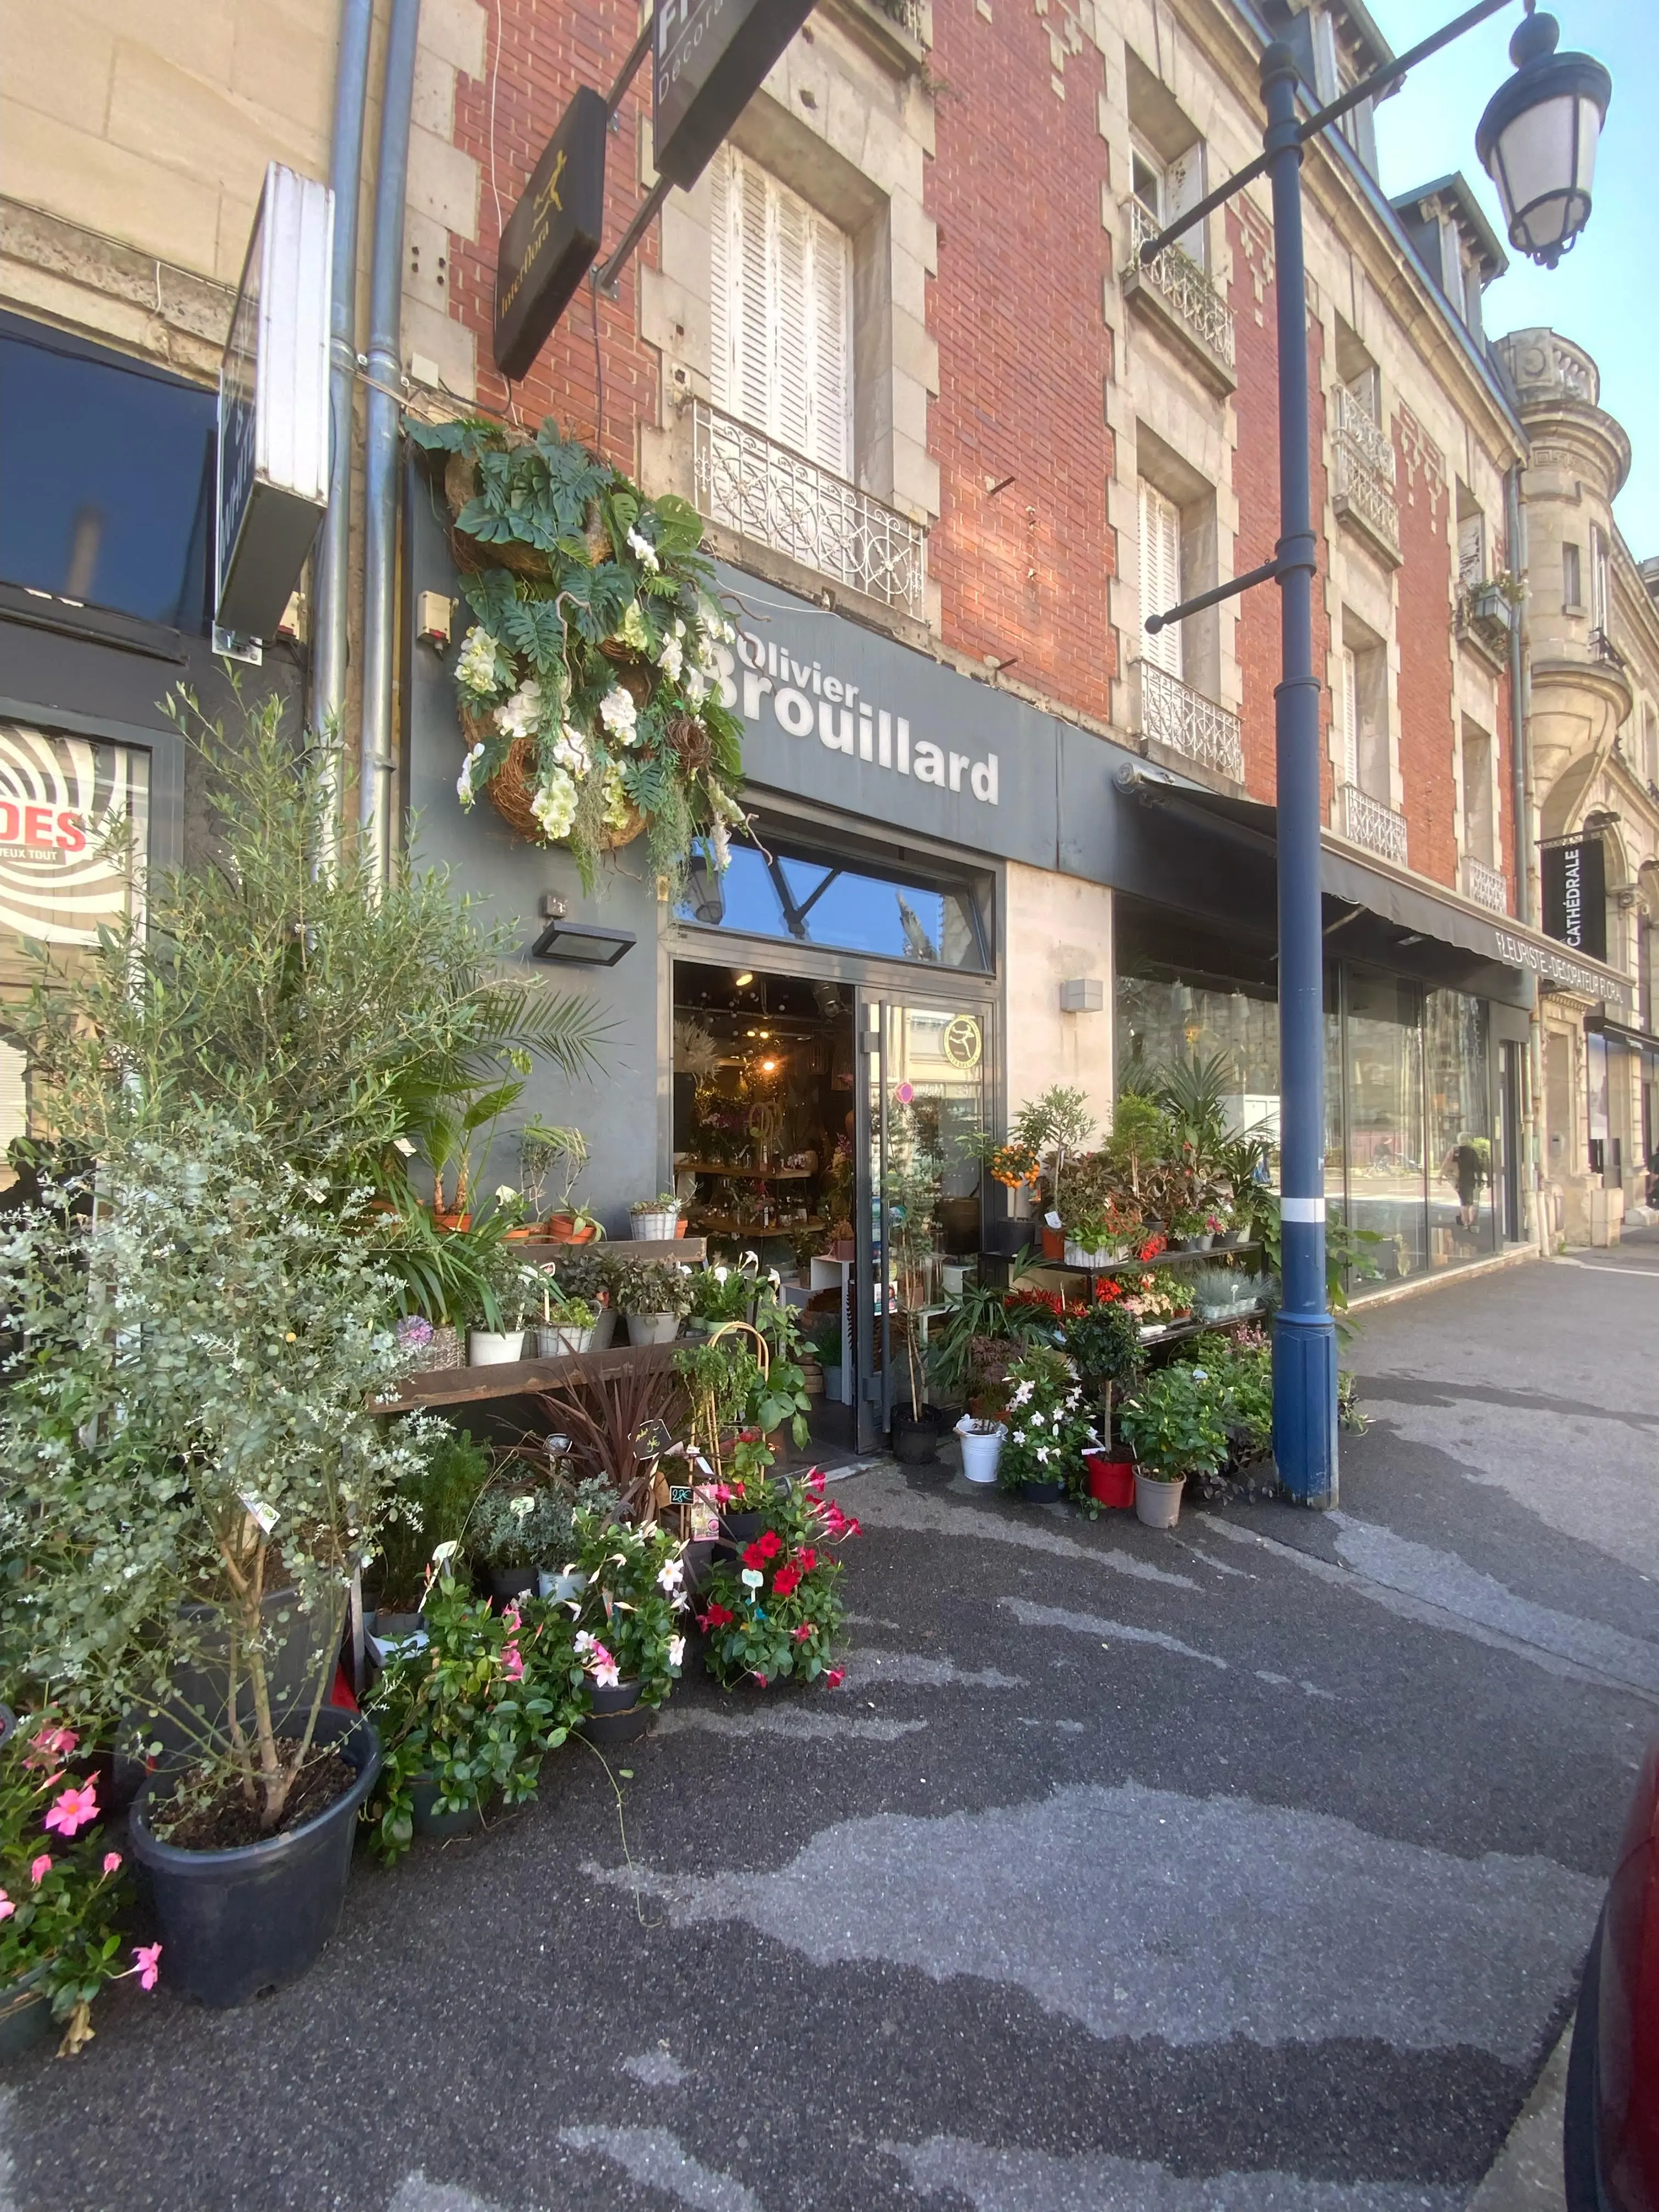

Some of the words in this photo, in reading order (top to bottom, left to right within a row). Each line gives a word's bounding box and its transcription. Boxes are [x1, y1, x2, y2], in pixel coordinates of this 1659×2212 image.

[736, 631, 859, 708] Olivier
[699, 641, 998, 806] Brouillard
[28, 849, 58, 861] TOUT
[1562, 849, 1581, 947] CATHÉDRALE
[1495, 932, 1548, 973] FLEURISTE
